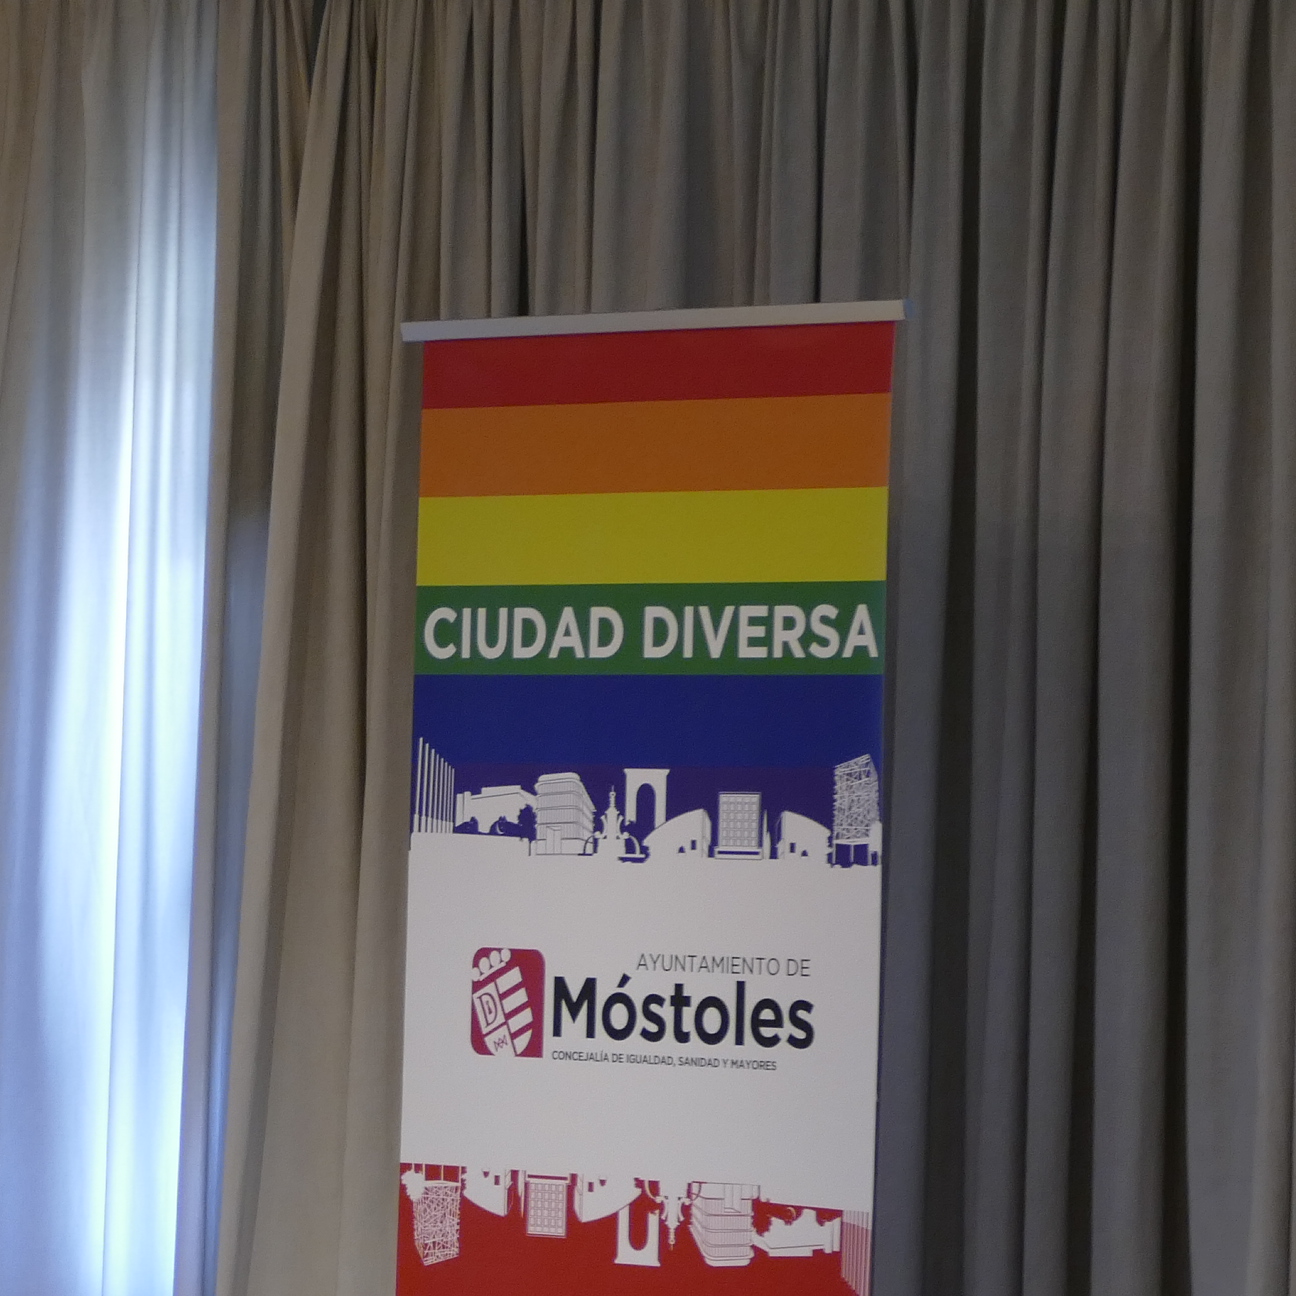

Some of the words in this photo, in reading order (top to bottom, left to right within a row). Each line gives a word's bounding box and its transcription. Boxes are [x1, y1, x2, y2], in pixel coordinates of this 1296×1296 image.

[424, 606, 624, 659] CIUDAD
[643, 604, 879, 659] DIVERSA
[636, 953, 781, 977] AYUNTAMIENTO
[786, 959, 811, 977] DE
[552, 972, 816, 1050] Móstoles
[551, 1050, 609, 1063] CONCEJALÍA
[611, 1053, 624, 1063] DE
[626, 1054, 676, 1067] IGUALDAD,
[677, 1056, 721, 1068] SANIDAD
[722, 1059, 729, 1068] Y
[730, 1060, 778, 1071] MAYORES
